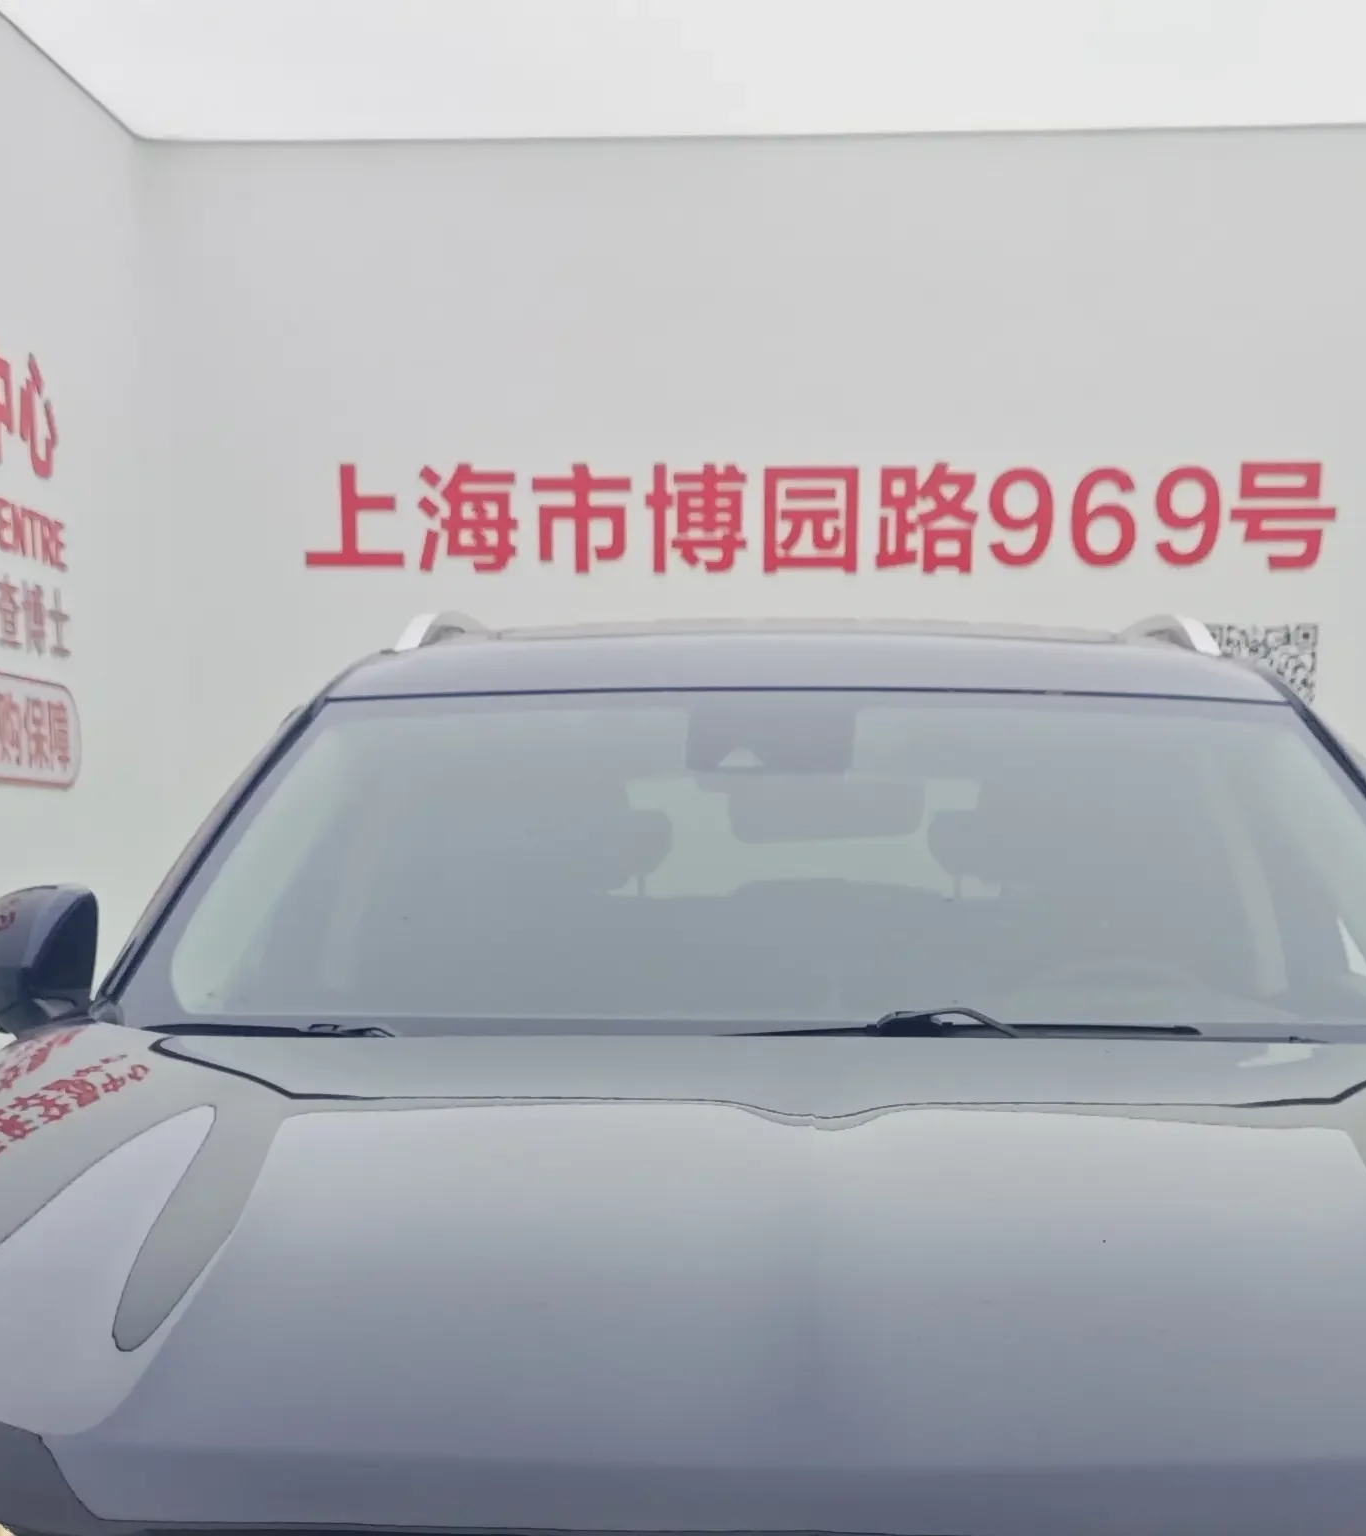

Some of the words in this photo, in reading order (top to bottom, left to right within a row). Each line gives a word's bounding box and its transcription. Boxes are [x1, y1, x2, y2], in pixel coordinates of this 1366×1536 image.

[305, 461, 1336, 576] 上海市博园路969号
